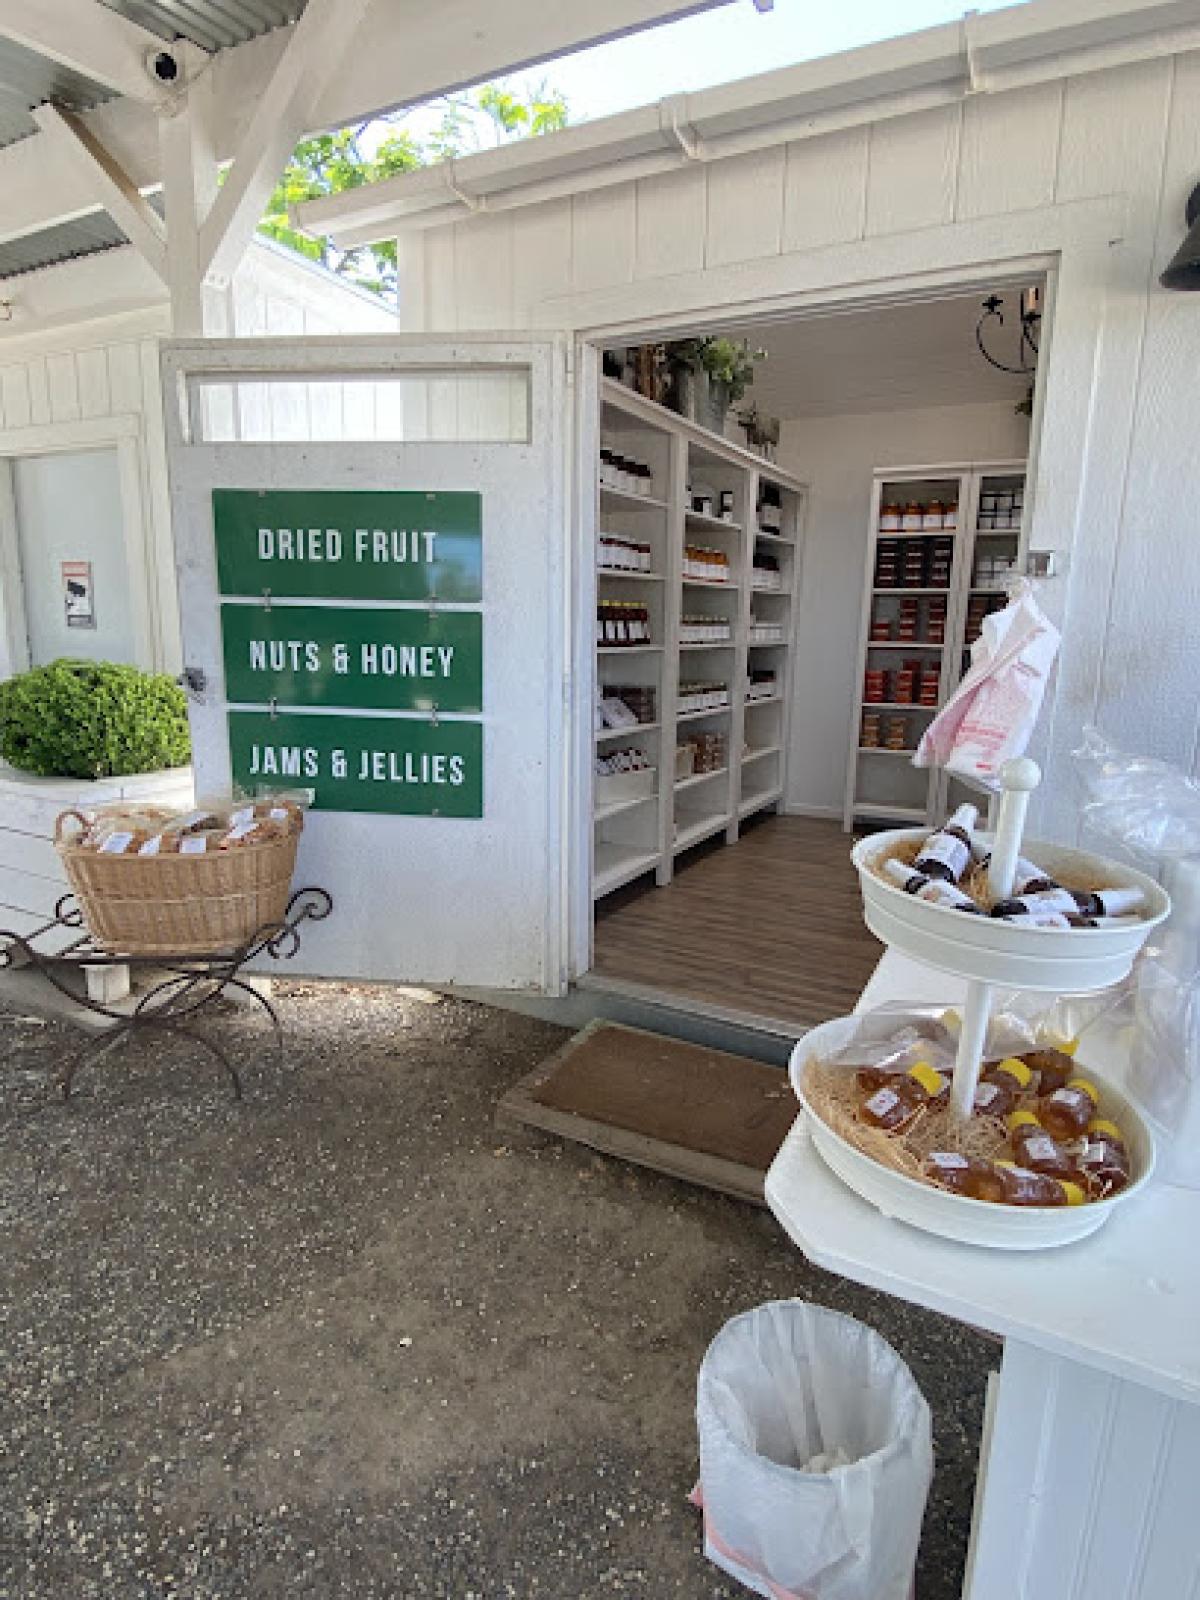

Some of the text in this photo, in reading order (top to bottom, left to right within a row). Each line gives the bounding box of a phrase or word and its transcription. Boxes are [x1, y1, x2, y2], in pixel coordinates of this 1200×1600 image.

[258, 528, 437, 563] DRIED FRUIT
[249, 640, 454, 677] NUTS & HONEY
[249, 745, 465, 786] JAMS & JELLIES
